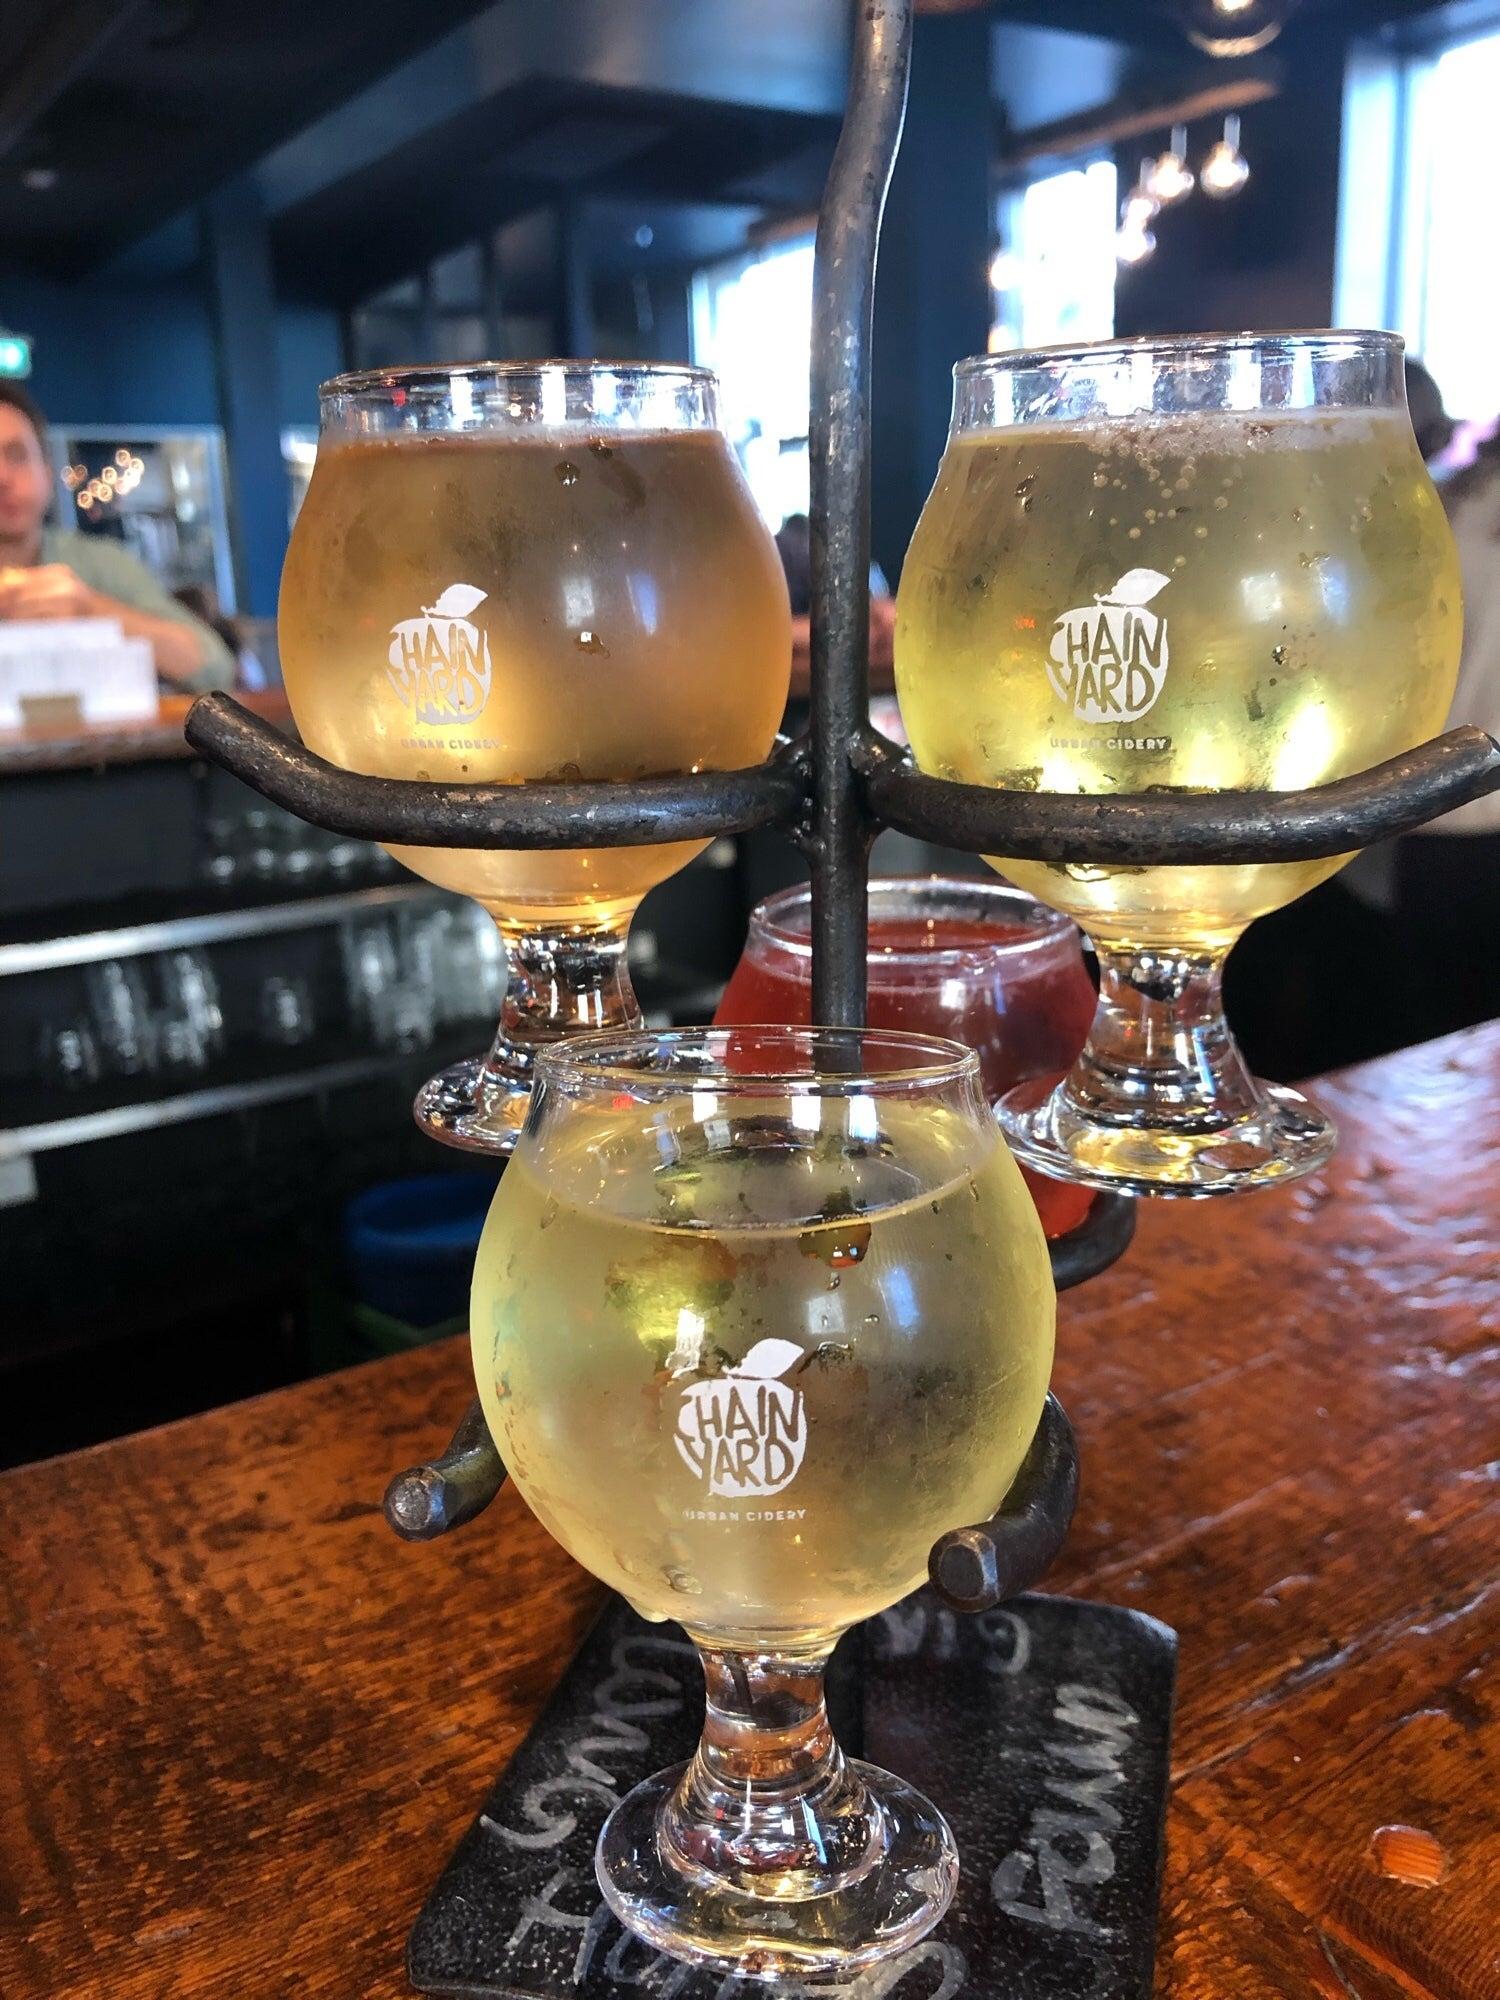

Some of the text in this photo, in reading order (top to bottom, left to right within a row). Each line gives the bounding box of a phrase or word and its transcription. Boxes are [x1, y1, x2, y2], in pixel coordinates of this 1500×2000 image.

[385, 622, 488, 678] CHAIN
[1047, 611, 1165, 670] CHAIN
[386, 668, 486, 721] YARD
[1047, 660, 1156, 717] YARD
[1105, 737, 1167, 750] CIDERY
[677, 1384, 801, 1443] CHAIN
[675, 1432, 795, 1491] YARD
[682, 1508, 806, 1521] URBAN CIDERY
